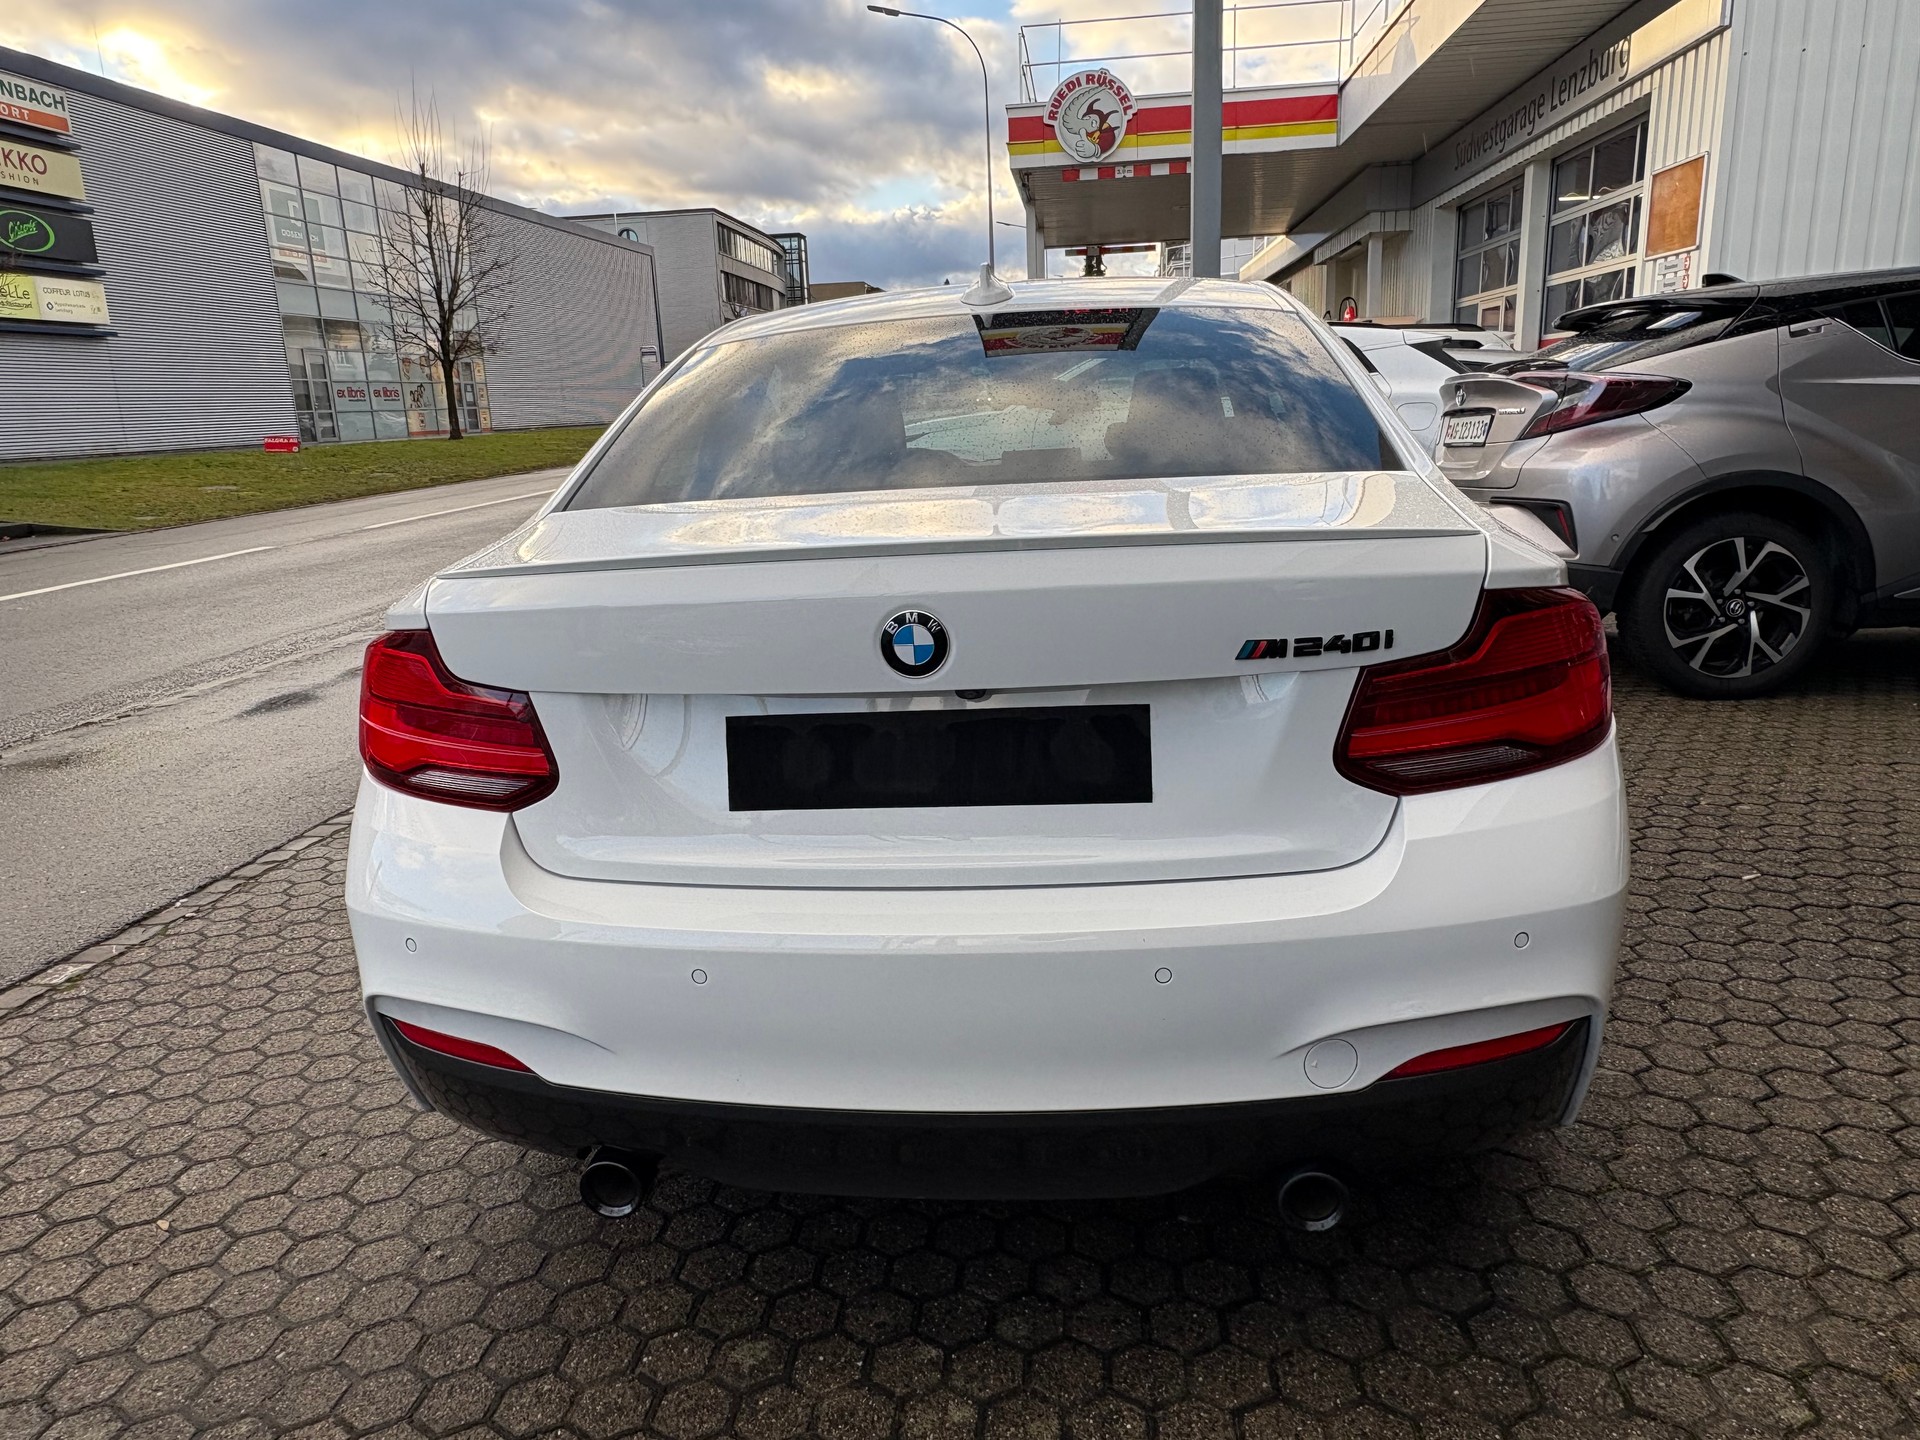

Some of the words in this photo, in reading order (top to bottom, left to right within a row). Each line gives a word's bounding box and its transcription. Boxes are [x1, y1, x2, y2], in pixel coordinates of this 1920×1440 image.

[1048, 76, 1083, 121] RUEDI
[1085, 71, 1134, 116] RÜSSEL
[1454, 93, 1546, 171] Südwestgarage
[1550, 35, 1632, 112] Lenzburg
[0, 147, 48, 175] KKO
[42, 287, 71, 296] COIFFEUR
[73, 289, 91, 298] LOTUS
[337, 389, 346, 398] ex
[347, 386, 366, 398] libris
[373, 389, 382, 398] ex
[382, 386, 400, 398] libris
[886, 612, 940, 635] BMW
